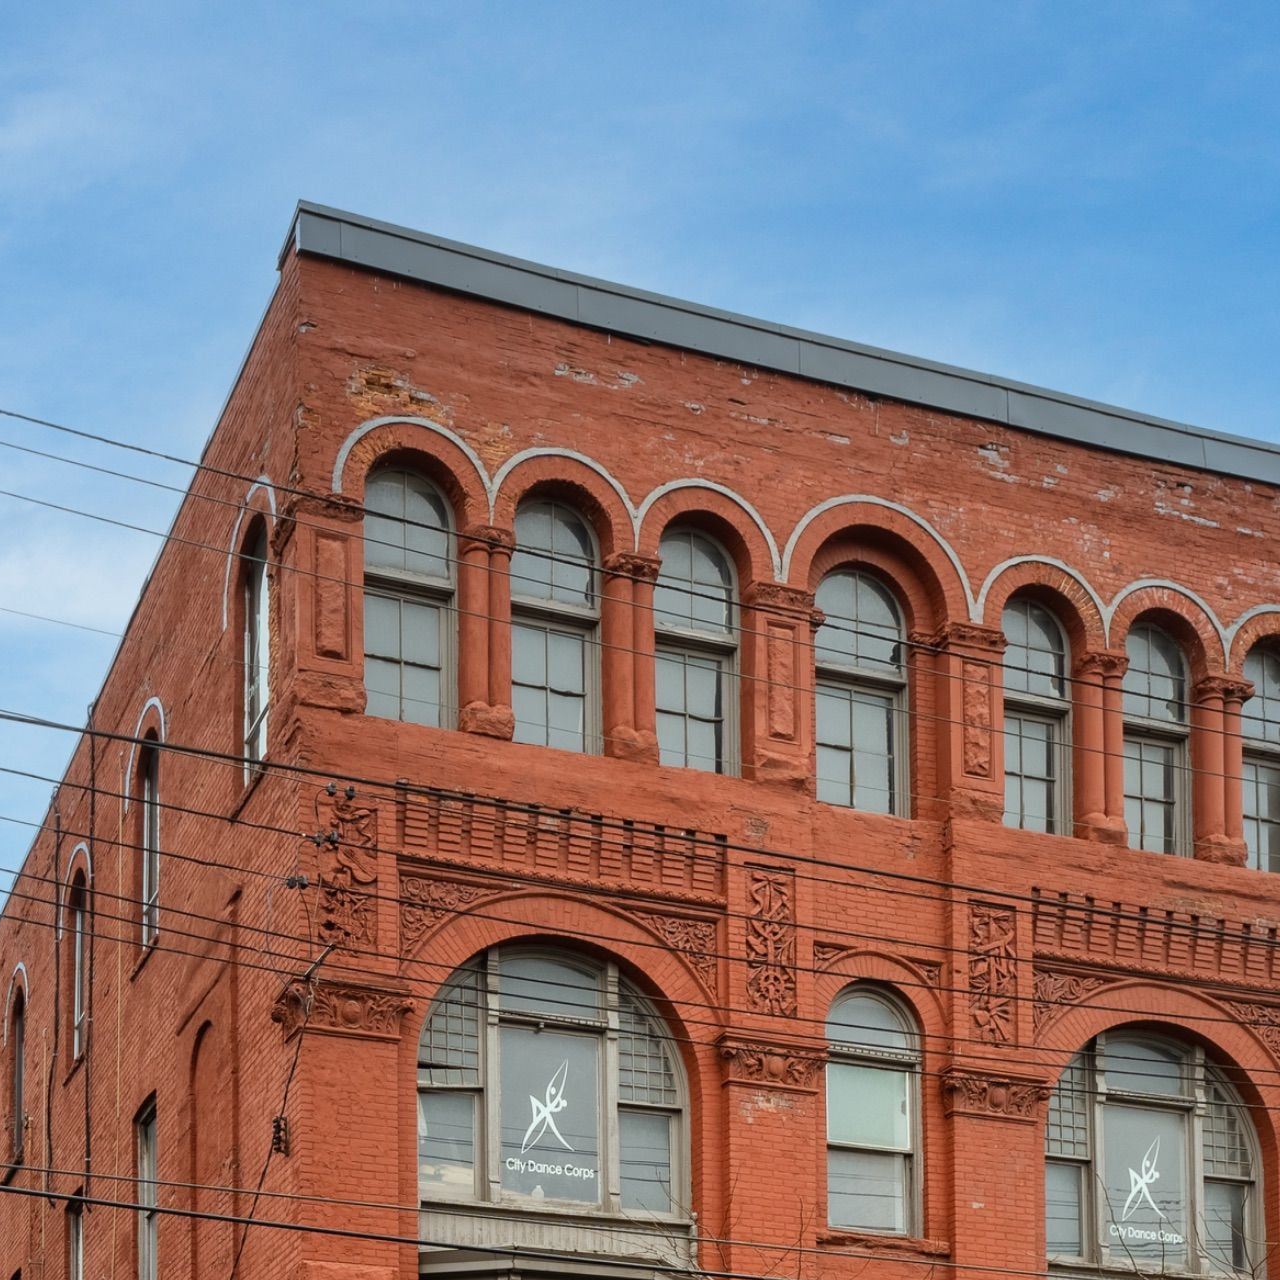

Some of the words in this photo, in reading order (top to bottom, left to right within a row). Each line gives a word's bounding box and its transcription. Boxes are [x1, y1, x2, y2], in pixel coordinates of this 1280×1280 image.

[506, 1158, 527, 1173] City
[528, 1160, 562, 1175] Dance
[564, 1164, 594, 1180] Corps
[1109, 1225, 1127, 1239] City
[1128, 1227, 1156, 1240] Dance
[1158, 1230, 1184, 1244] Corps
